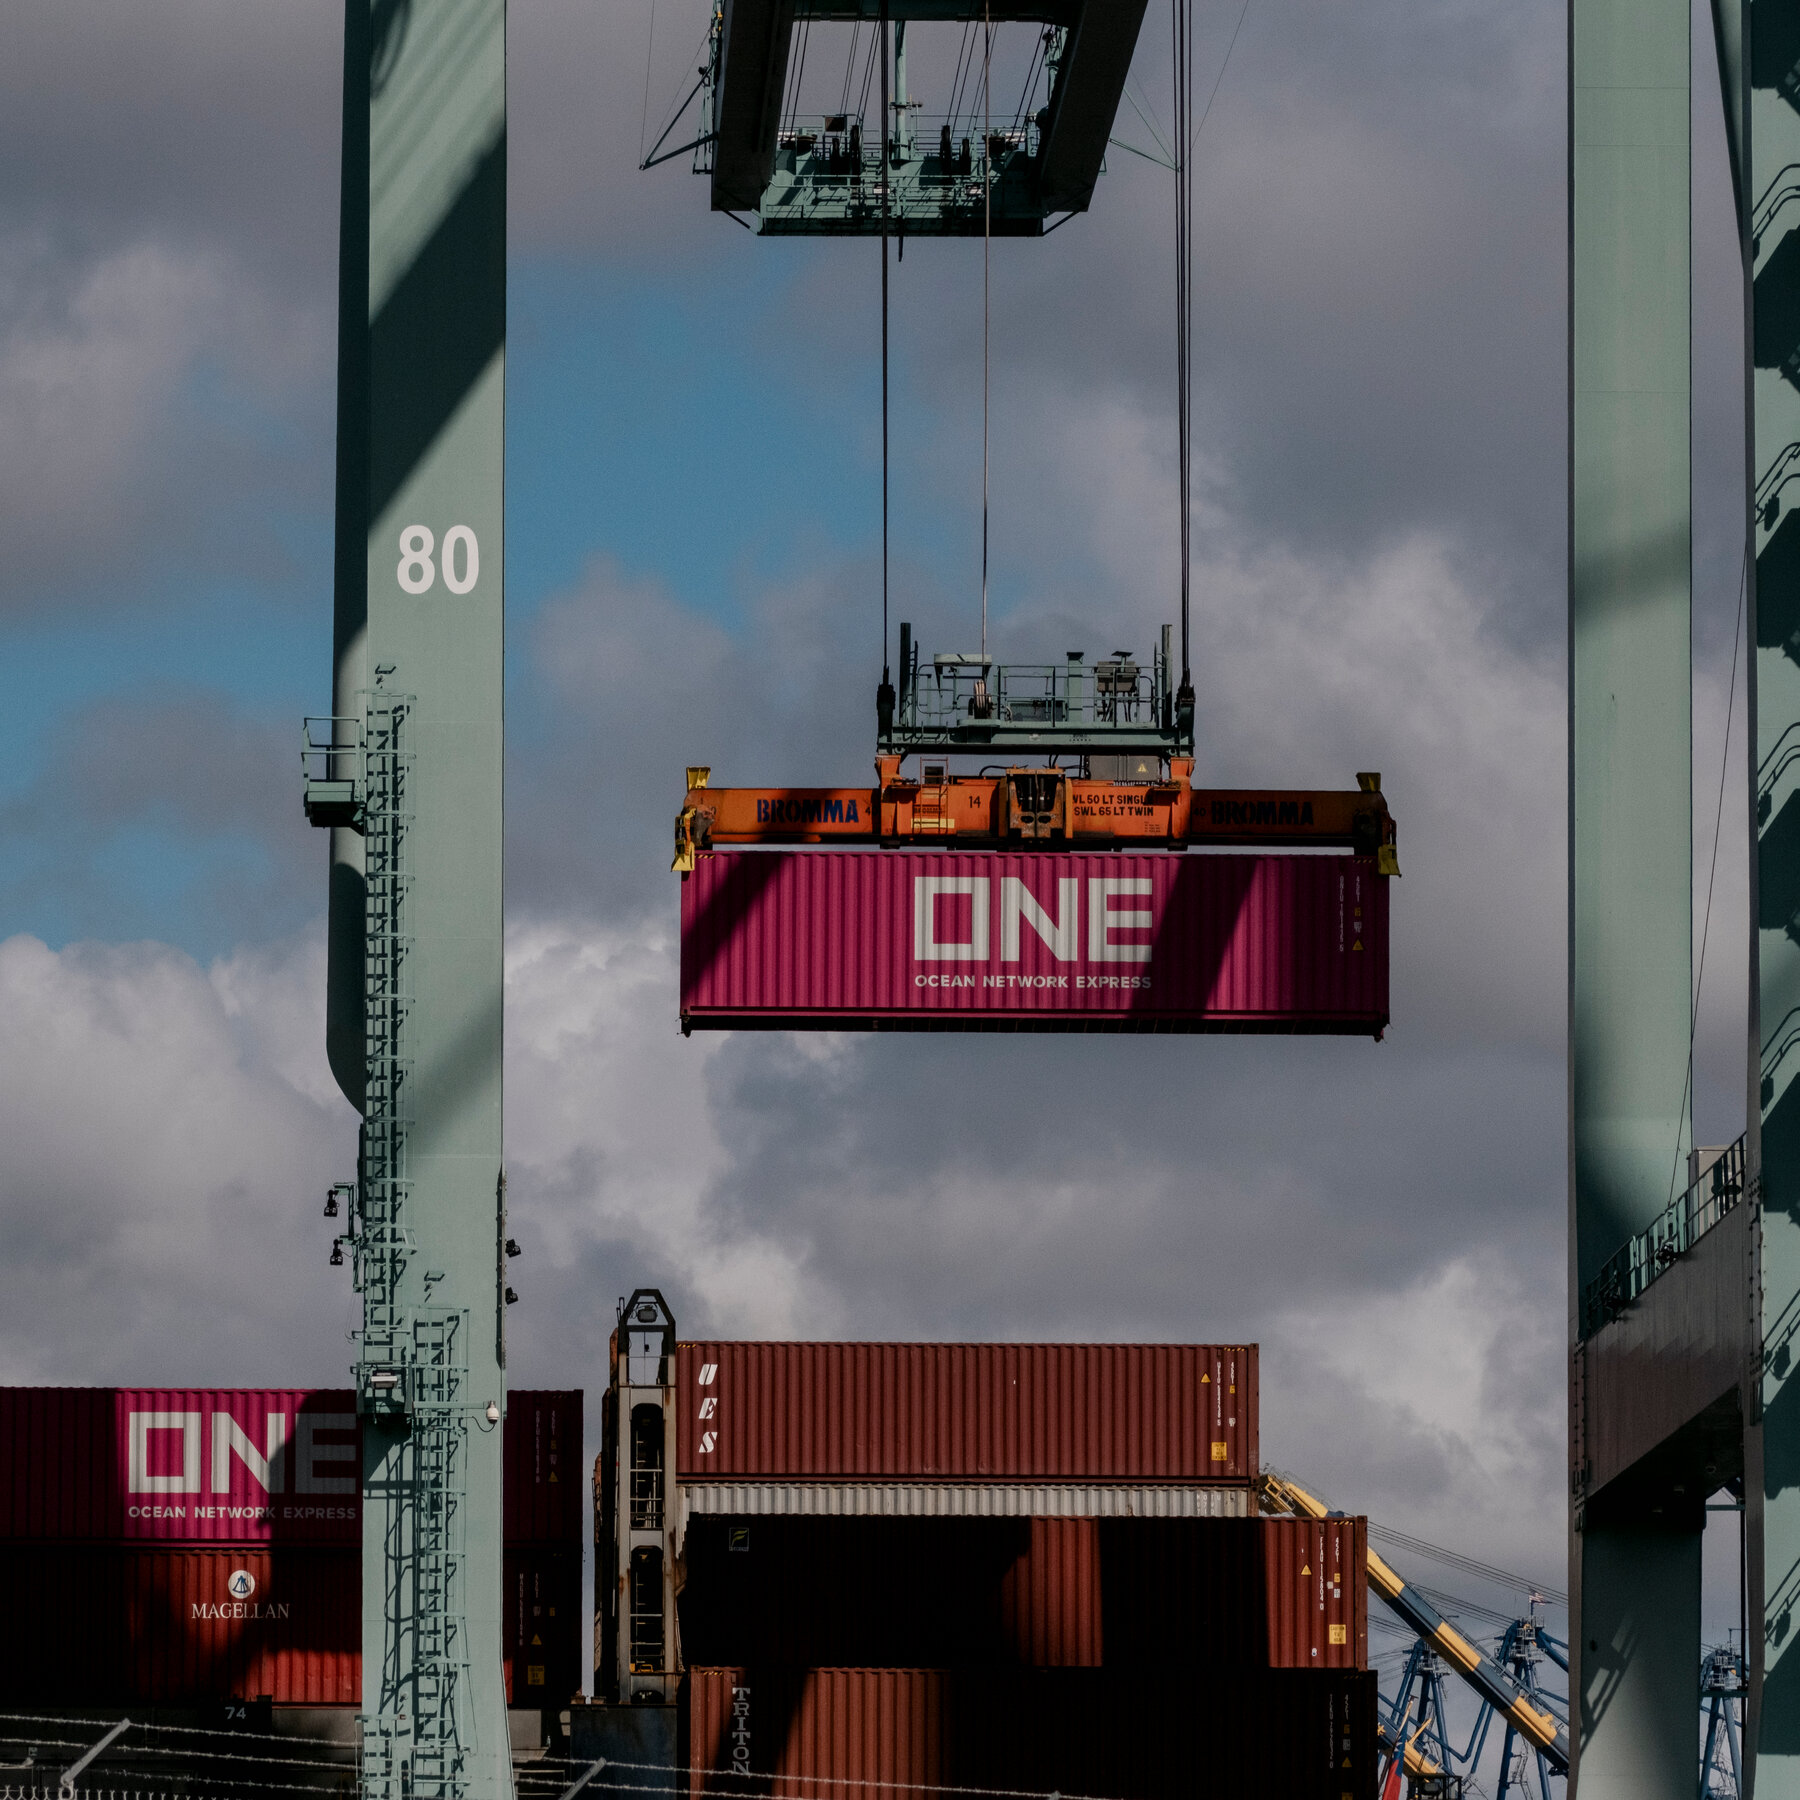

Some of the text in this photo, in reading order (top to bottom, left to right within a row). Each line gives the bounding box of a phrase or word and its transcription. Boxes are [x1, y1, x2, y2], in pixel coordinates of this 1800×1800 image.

[397, 524, 479, 595] 80
[968, 795, 981, 809] 14
[1087, 794, 1100, 805] 50
[1102, 794, 1114, 805] LT
[756, 798, 860, 824] BROMMA
[1074, 806, 1154, 817] SWL 65 LT TWIN
[1211, 800, 1314, 826] BROMMA
[914, 876, 1153, 963] ONE
[914, 974, 1153, 990] OCEAN NETWORK EXPRESS
[127, 1411, 357, 1495] ONE
[127, 1505, 357, 1520] OCEAN NETWORK EXPRESS
[191, 1602, 290, 1620] MAGELLAN
[224, 1705, 248, 1721] 74
[731, 1686, 752, 1775] TRITON
